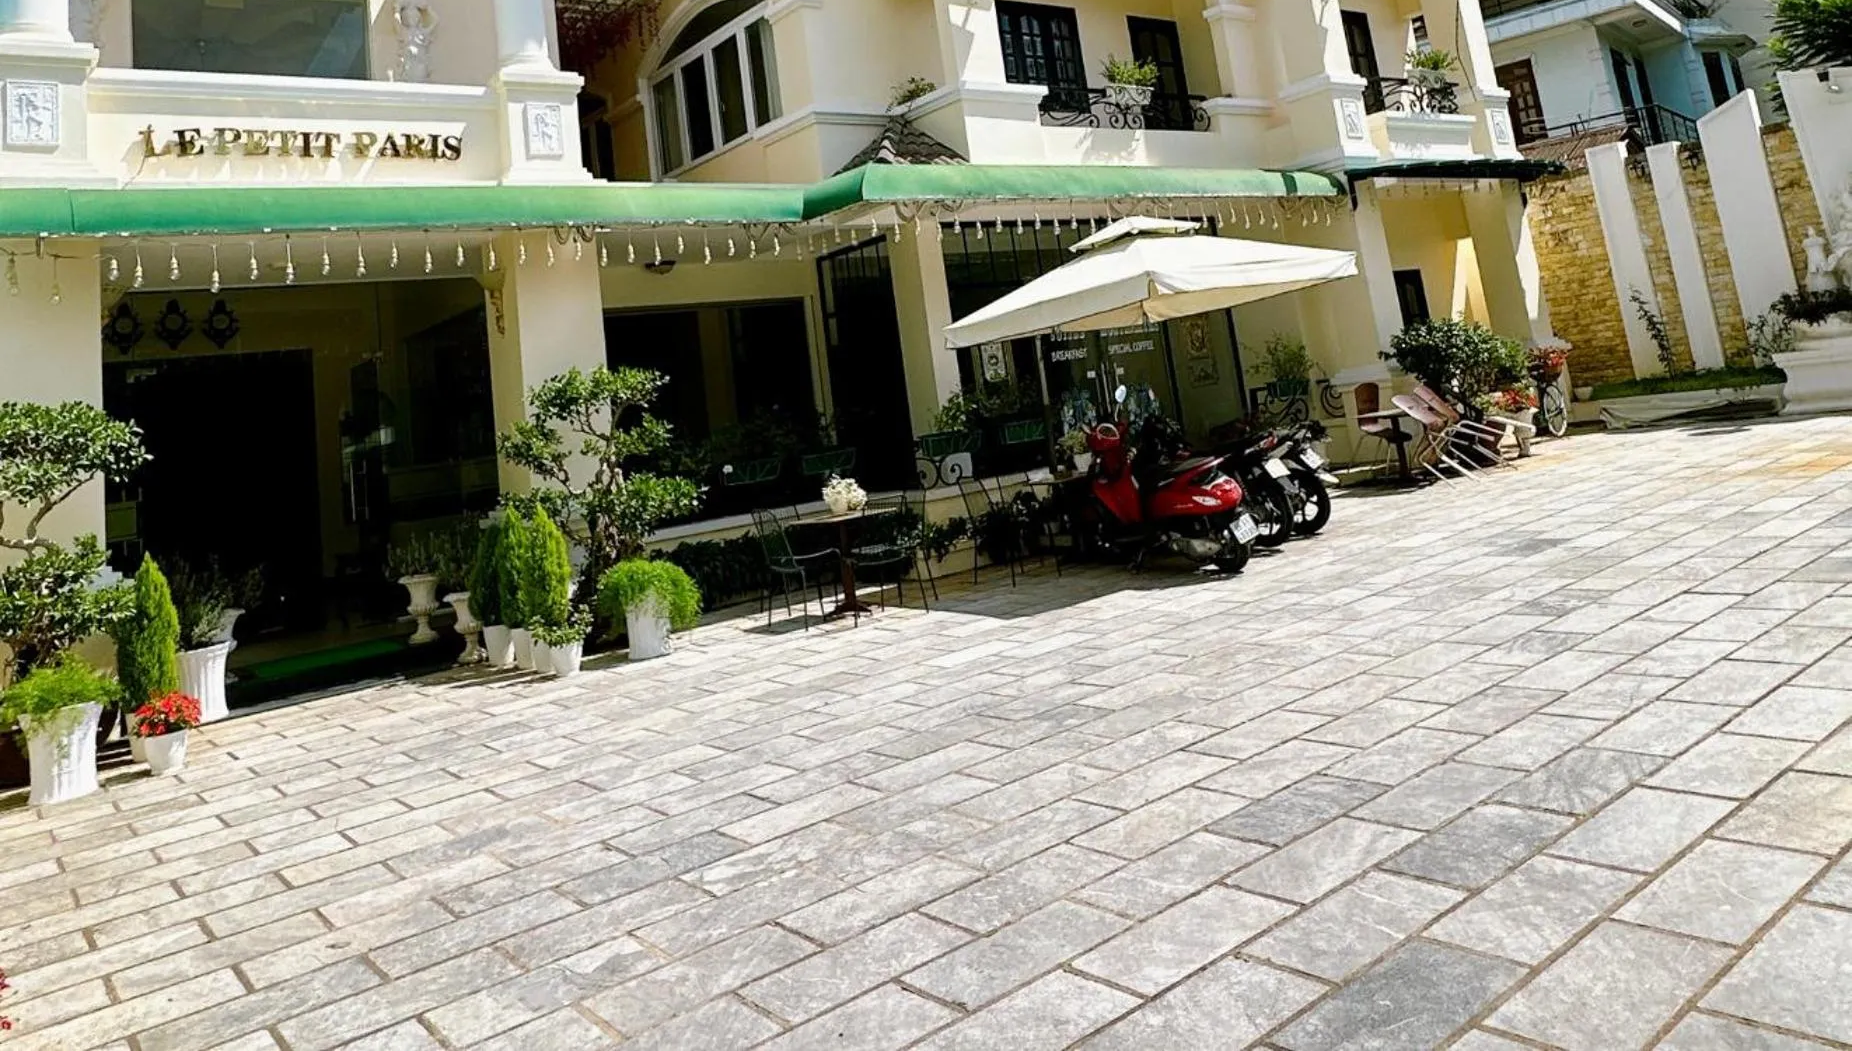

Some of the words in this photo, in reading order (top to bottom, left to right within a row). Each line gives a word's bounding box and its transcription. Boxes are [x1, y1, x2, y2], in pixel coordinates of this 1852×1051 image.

[138, 127, 204, 158] LE
[213, 127, 341, 158] PETIT
[352, 130, 462, 161] PARIS
